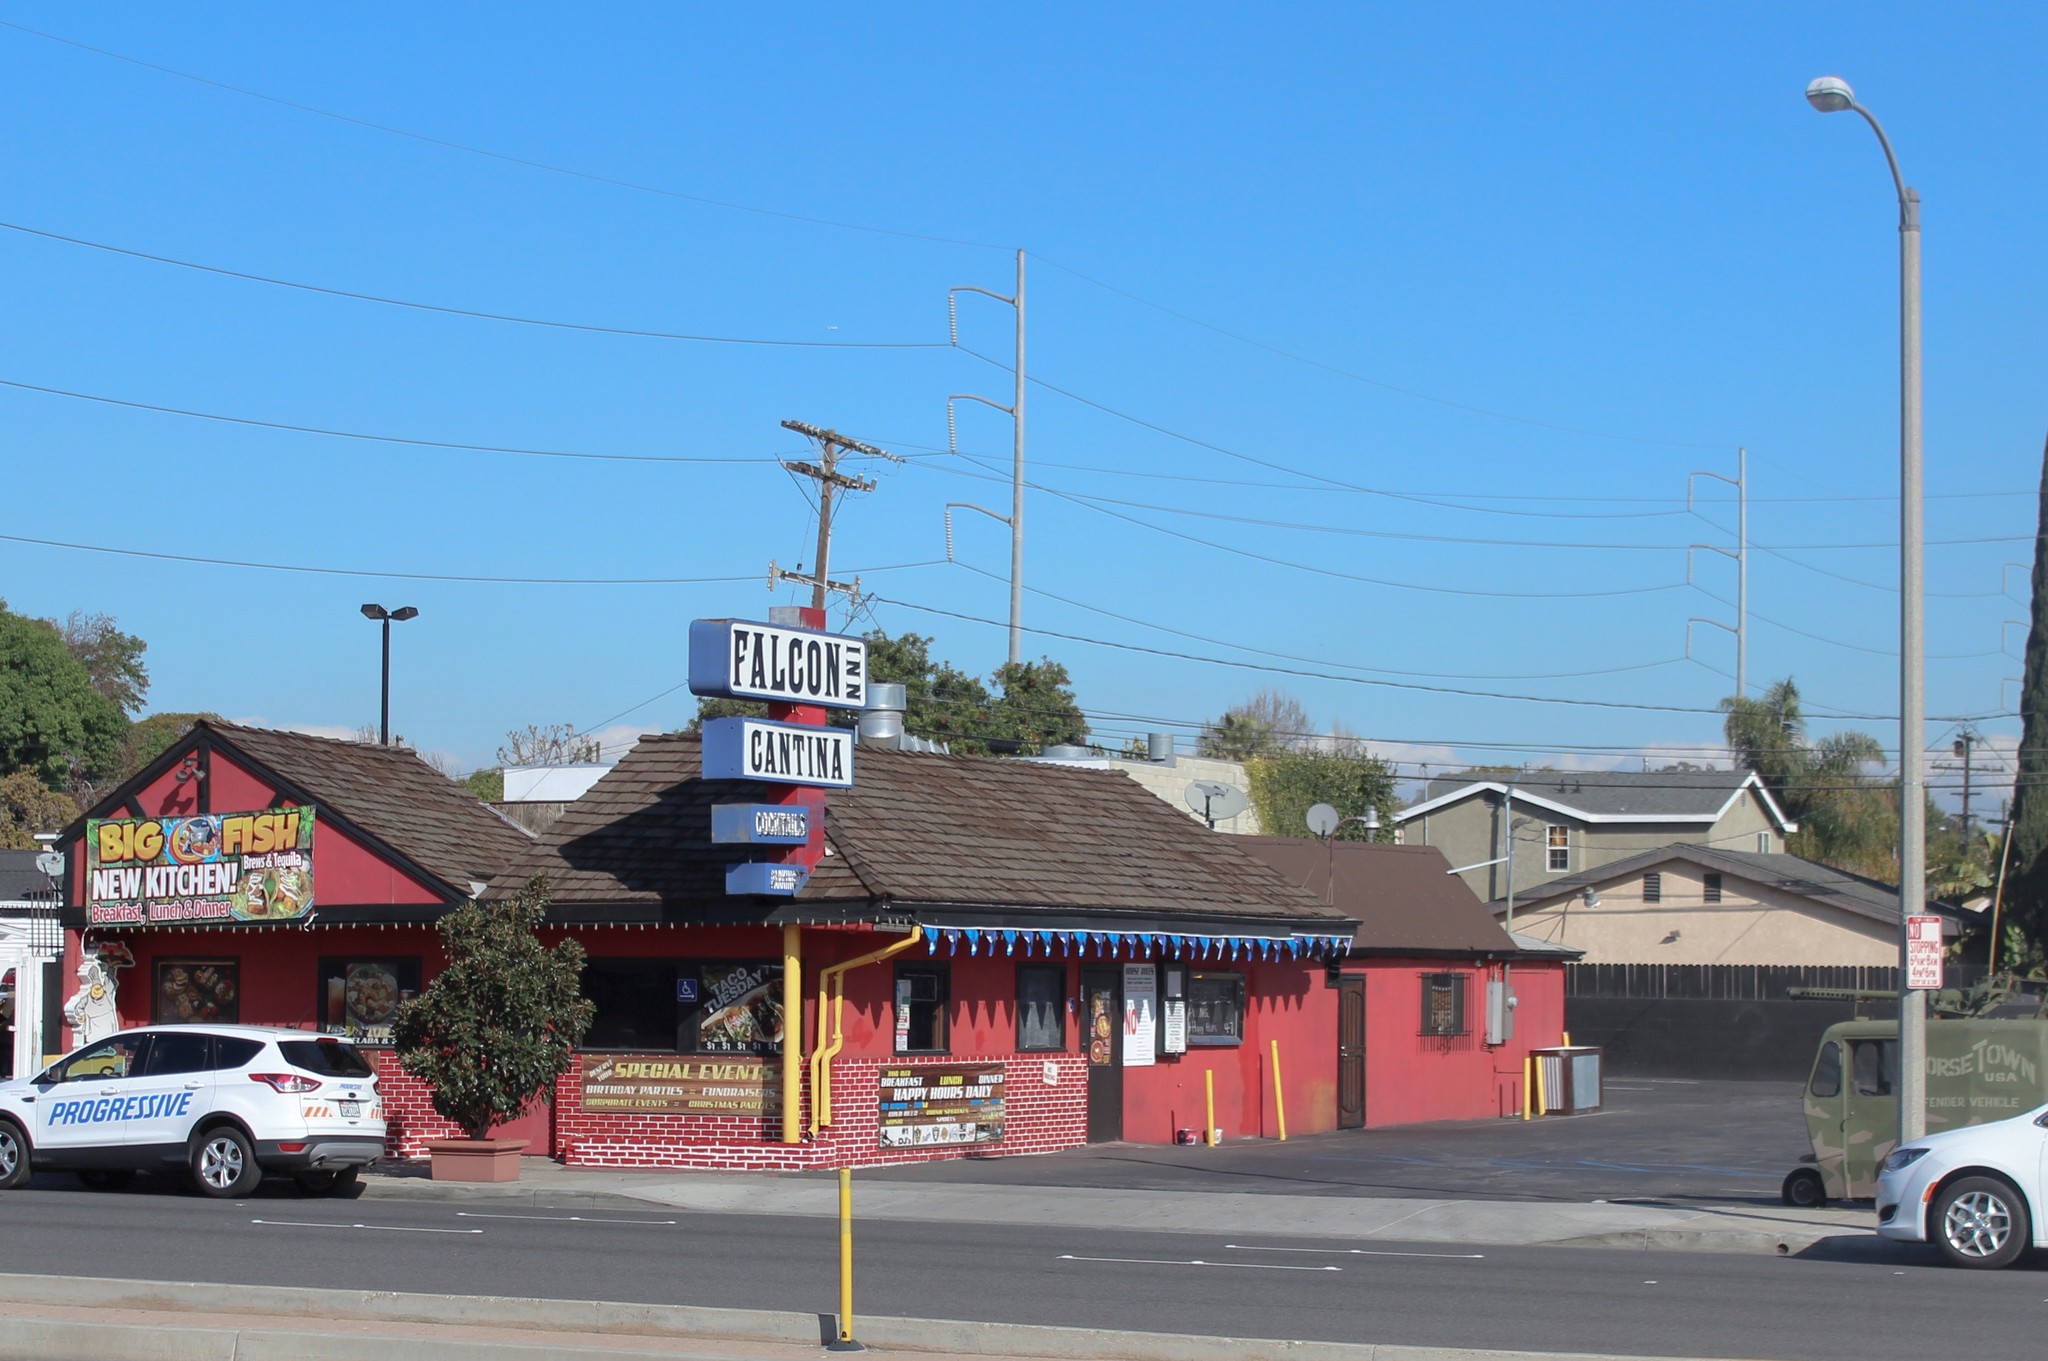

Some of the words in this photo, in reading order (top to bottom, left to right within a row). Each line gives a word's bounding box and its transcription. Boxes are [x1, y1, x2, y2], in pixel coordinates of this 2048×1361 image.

[734, 630, 840, 697] FALCON
[846, 645, 860, 702] INN
[751, 730, 844, 780] CANTINA
[756, 812, 806, 836] COCKTAILS
[100, 821, 164, 862] BIG
[222, 813, 300, 856] FISH
[244, 855, 264, 870] Brews
[266, 854, 272, 868] &
[274, 852, 302, 868] Tequila
[92, 868, 142, 900] NEW
[145, 862, 238, 898] KITCHEN!
[91, 904, 146, 924] Breakfast,
[150, 902, 182, 920] Lunch
[184, 904, 193, 919] &
[194, 901, 232, 919] Dinner
[1908, 924, 1920, 938] NO
[1910, 941, 1938, 954] STOPPING
[710, 968, 747, 996] TACO
[1125, 1009, 1138, 1036] NO
[614, 1062, 692, 1079] SPECIAL
[698, 1064, 774, 1080] EVENTS
[1984, 1072, 2016, 1082] USA
[881, 1077, 923, 1087] BREAKFAST
[940, 1076, 963, 1085] LUNCH
[978, 1074, 1004, 1084] DINNER
[586, 1085, 637, 1094] BIRTHDAY
[640, 1086, 684, 1096] PARTIES
[702, 1087, 776, 1098] FUNDRAISERS
[893, 1087, 928, 1101] HAPPY
[930, 1086, 964, 1100] HOURS
[966, 1086, 993, 1098] DAILY
[48, 1092, 194, 1126] PROGRESSIVE
[586, 1098, 634, 1106] CORPORATE
[635, 1099, 668, 1107] EVENTS
[688, 1100, 738, 1109] CHRISTMAS
[740, 1101, 776, 1110] PARTIES
[1969, 1097, 2020, 1108] VEHICLE
